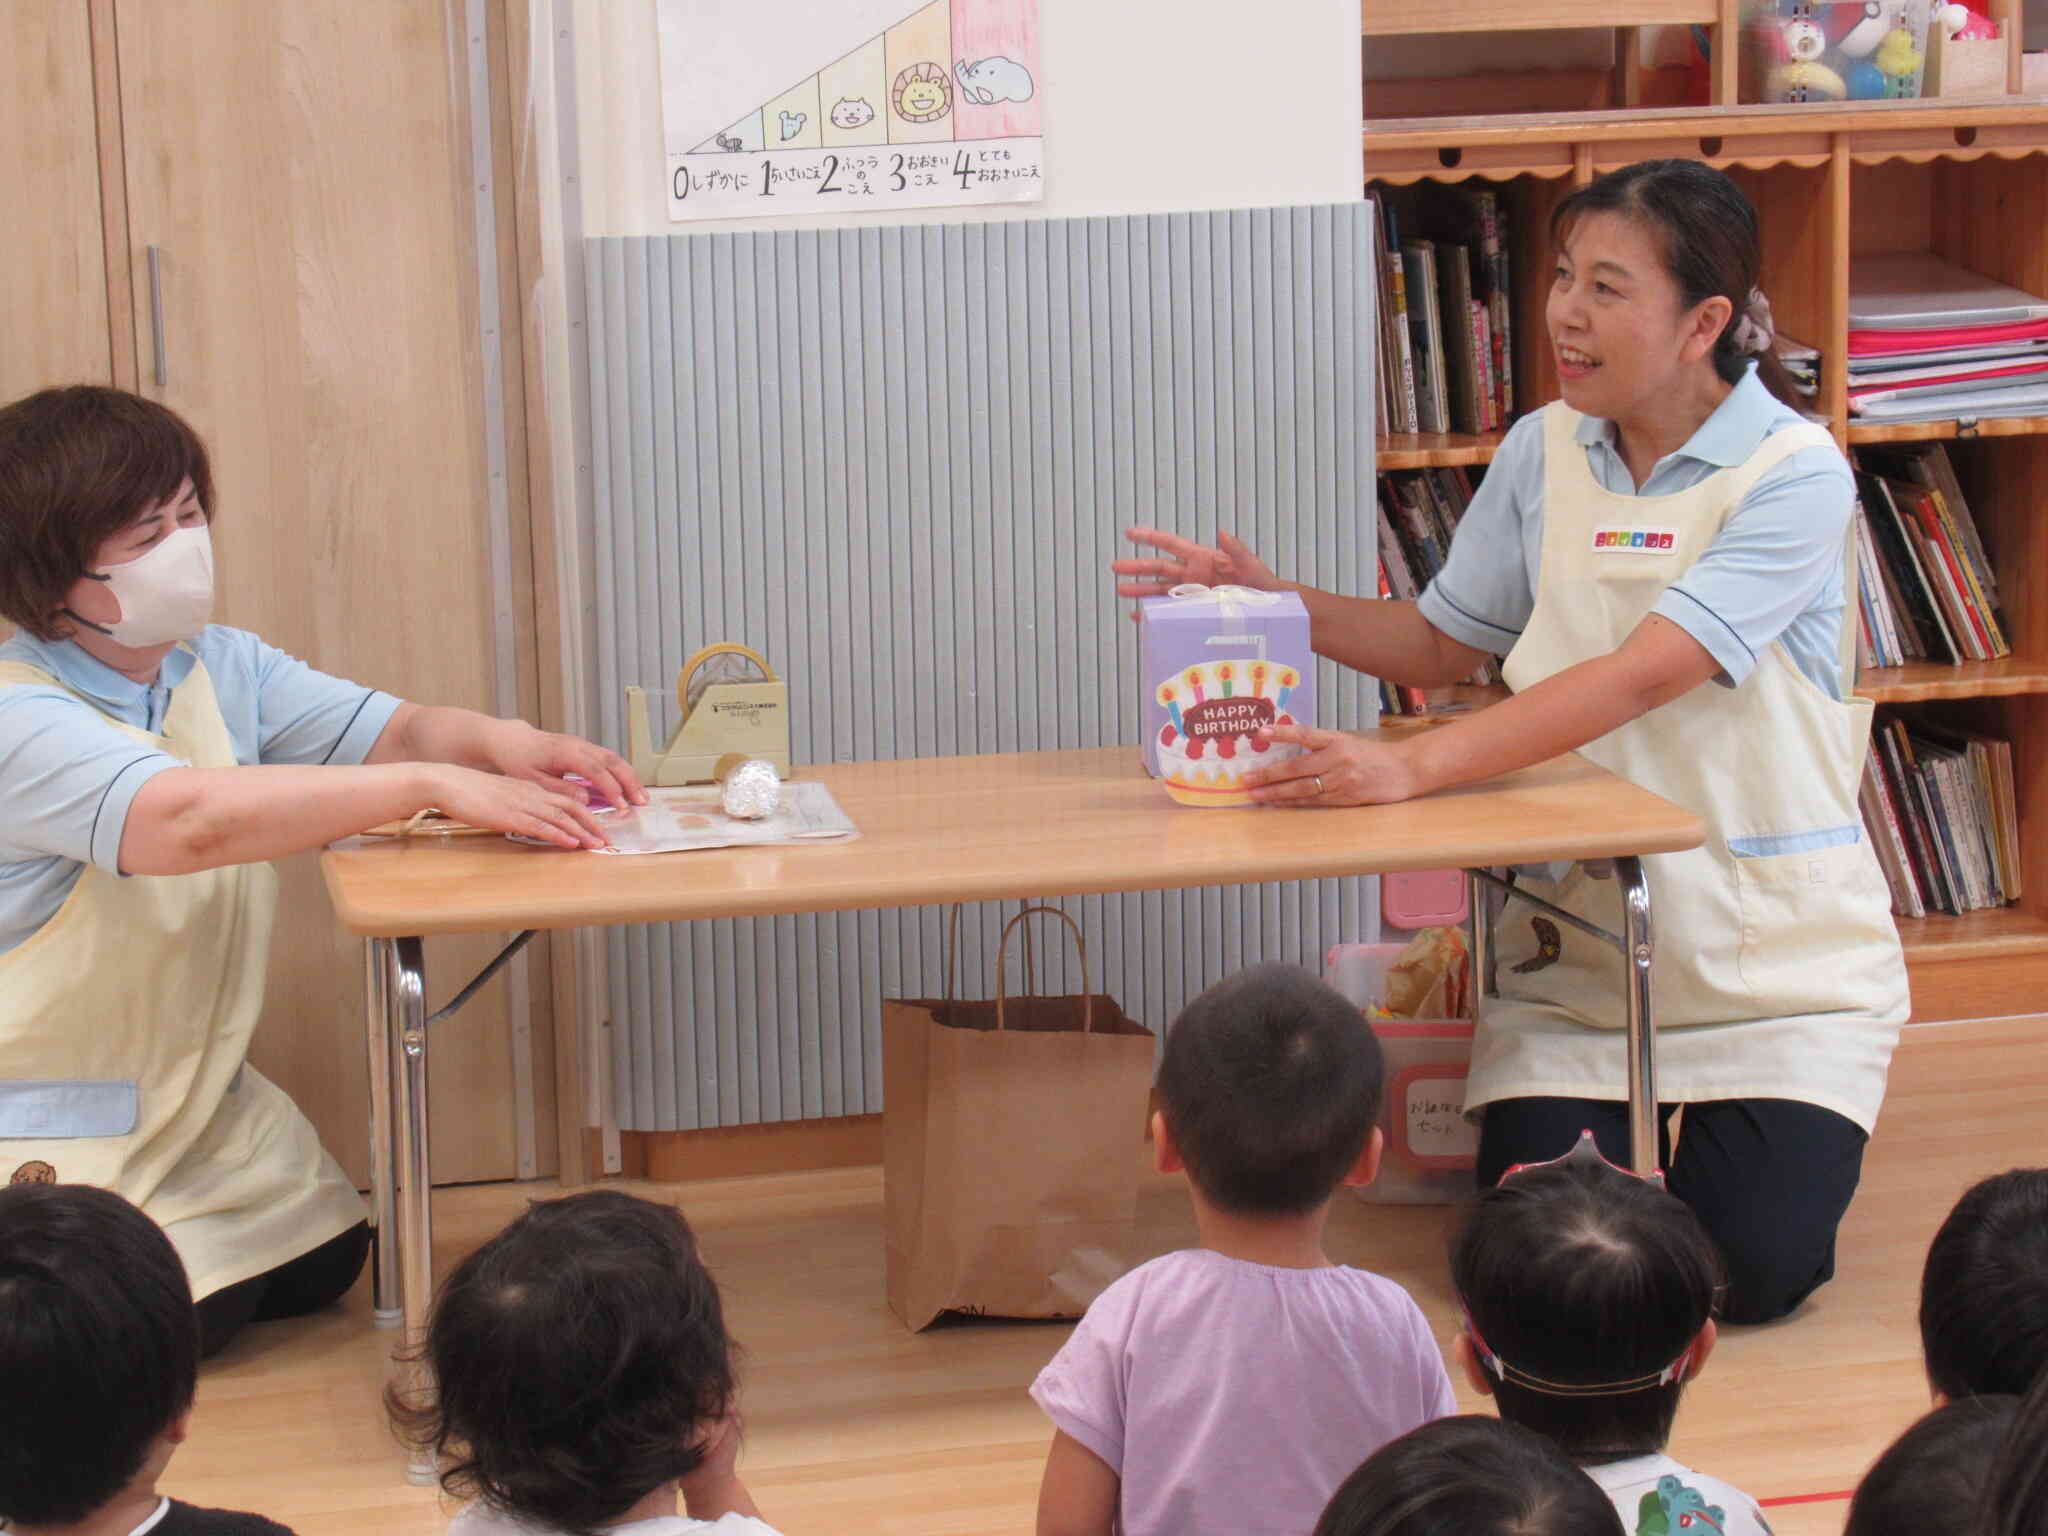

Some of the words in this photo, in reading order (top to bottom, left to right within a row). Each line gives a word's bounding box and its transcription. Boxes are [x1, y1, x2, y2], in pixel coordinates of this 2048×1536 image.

[771, 167, 822, 183] ちいさいこえ
[816, 155, 842, 194] 2
[842, 156, 879, 171] ふつう
[889, 153, 906, 191] 3
[907, 154, 949, 170] おおきい
[953, 149, 976, 190] 4
[978, 150, 1011, 162] とても
[978, 165, 1041, 182] おおきいこえ
[692, 169, 750, 192] しずかに
[914, 174, 939, 186] こえ
[847, 183, 875, 195] こえ
[1203, 705, 1257, 720] HAPPY
[1194, 718, 1269, 735] BIRTHDAY
